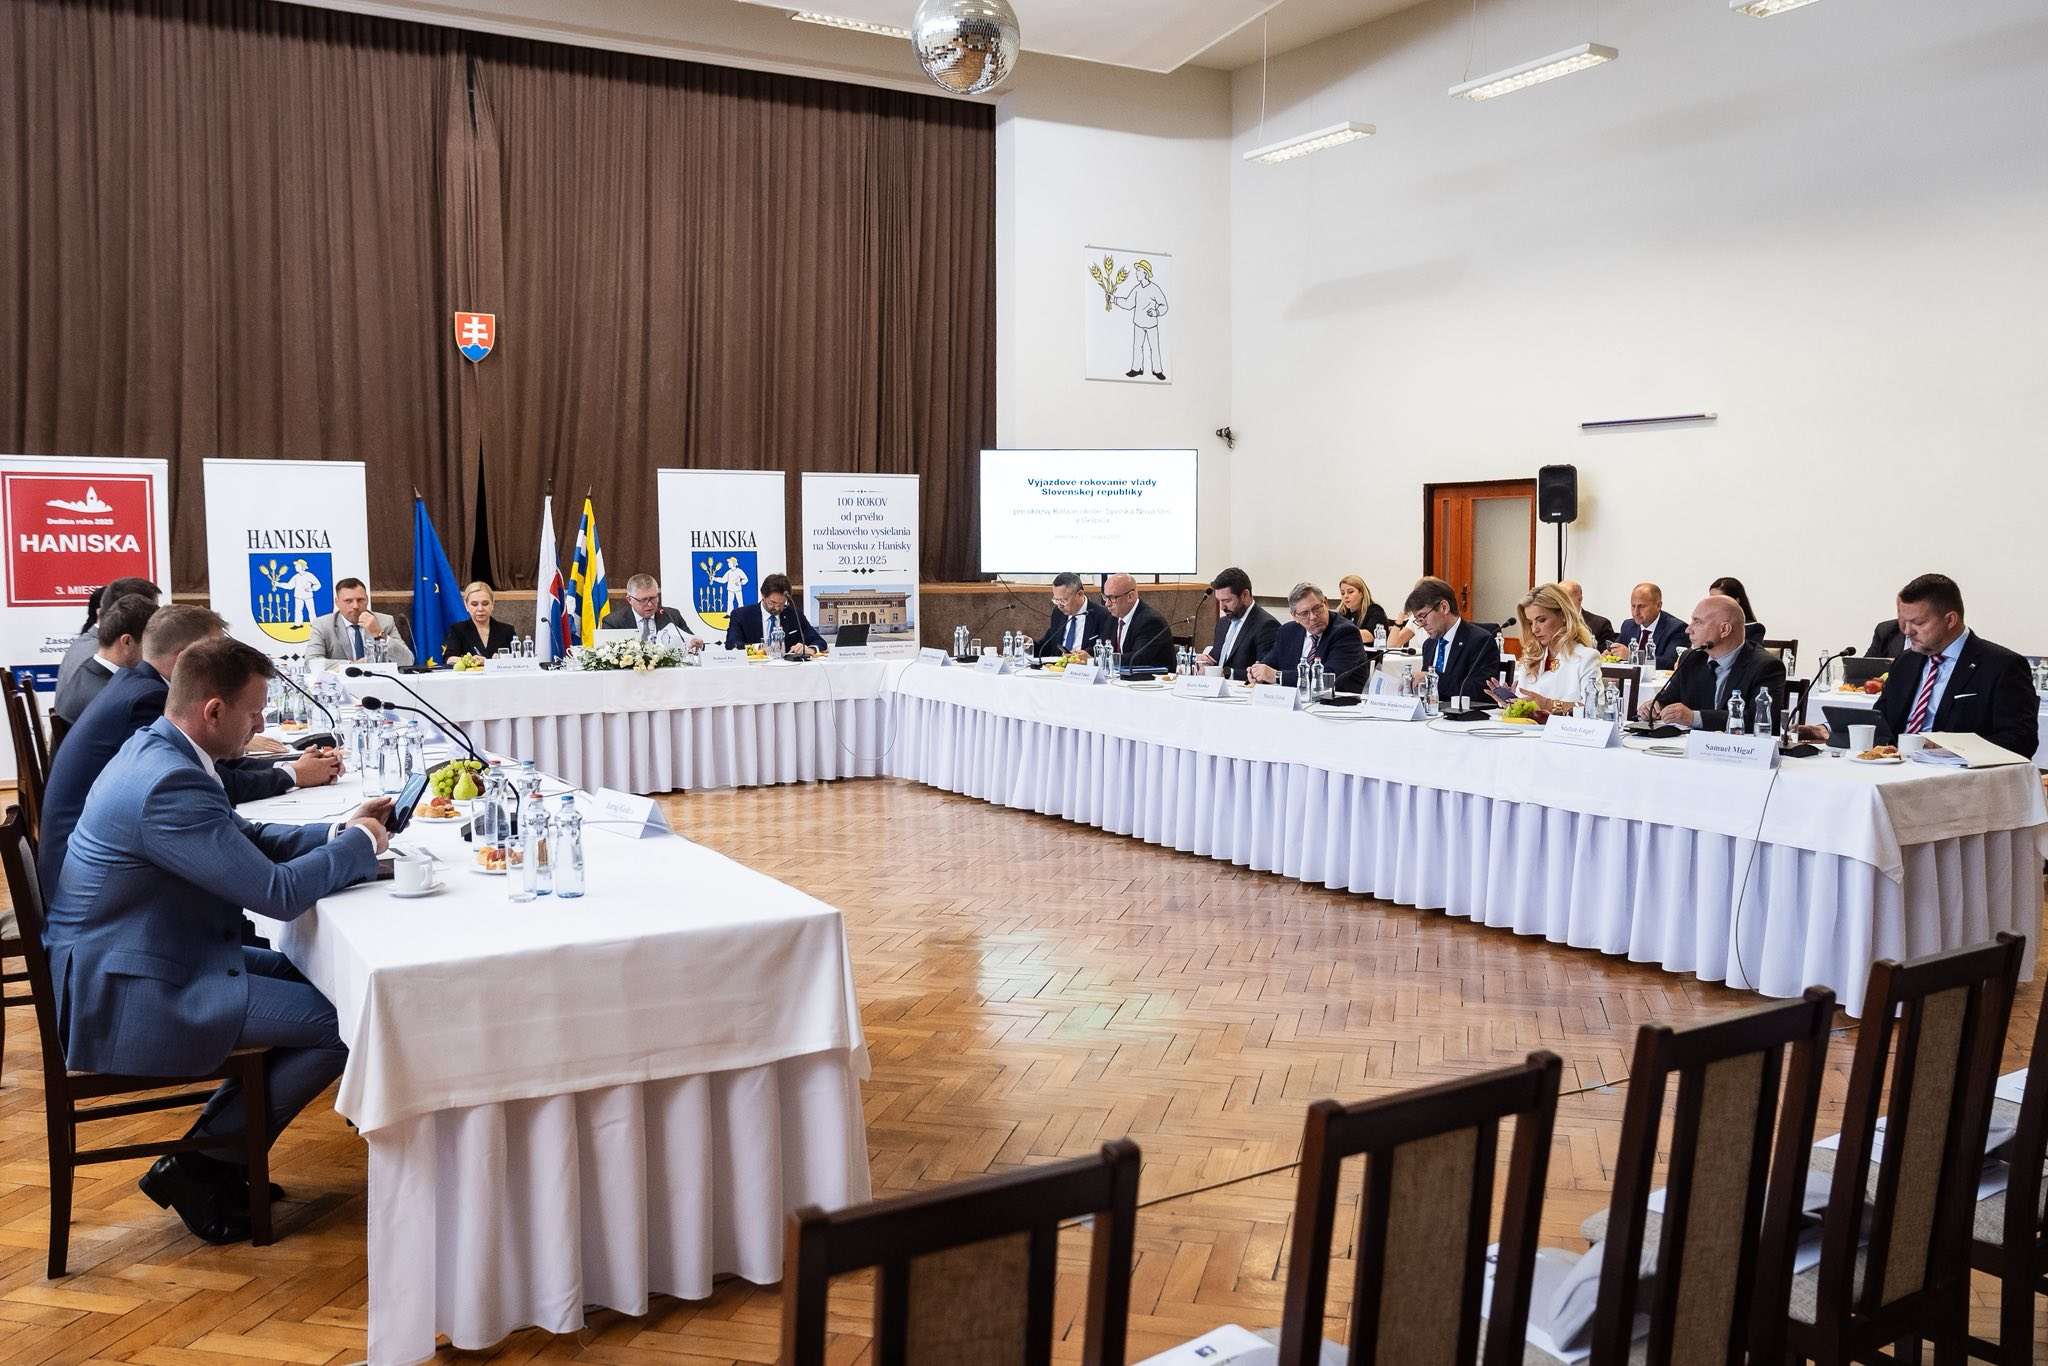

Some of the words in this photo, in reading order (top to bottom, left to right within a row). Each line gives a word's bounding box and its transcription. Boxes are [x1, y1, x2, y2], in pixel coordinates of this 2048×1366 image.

[1080, 478, 1127, 486] rokovanie
[1041, 488, 1094, 497] Slovenskej
[1097, 488, 1143, 497] republiky
[837, 497, 854, 507] 100
[856, 497, 888, 507] ROKOV
[840, 511, 852, 521] od
[813, 526, 868, 536] rozhlasového
[870, 526, 911, 538] vysielania
[20, 534, 140, 553] HANISKA
[247, 529, 332, 549] HANISKA
[691, 530, 757, 548] HANISKA
[826, 541, 868, 550] Slovensku
[878, 541, 912, 552] Hanisky
[838, 555, 887, 565] 20.12.1925
[67, 585, 104, 595] MIES
[1705, 743, 1730, 752] Samuel
